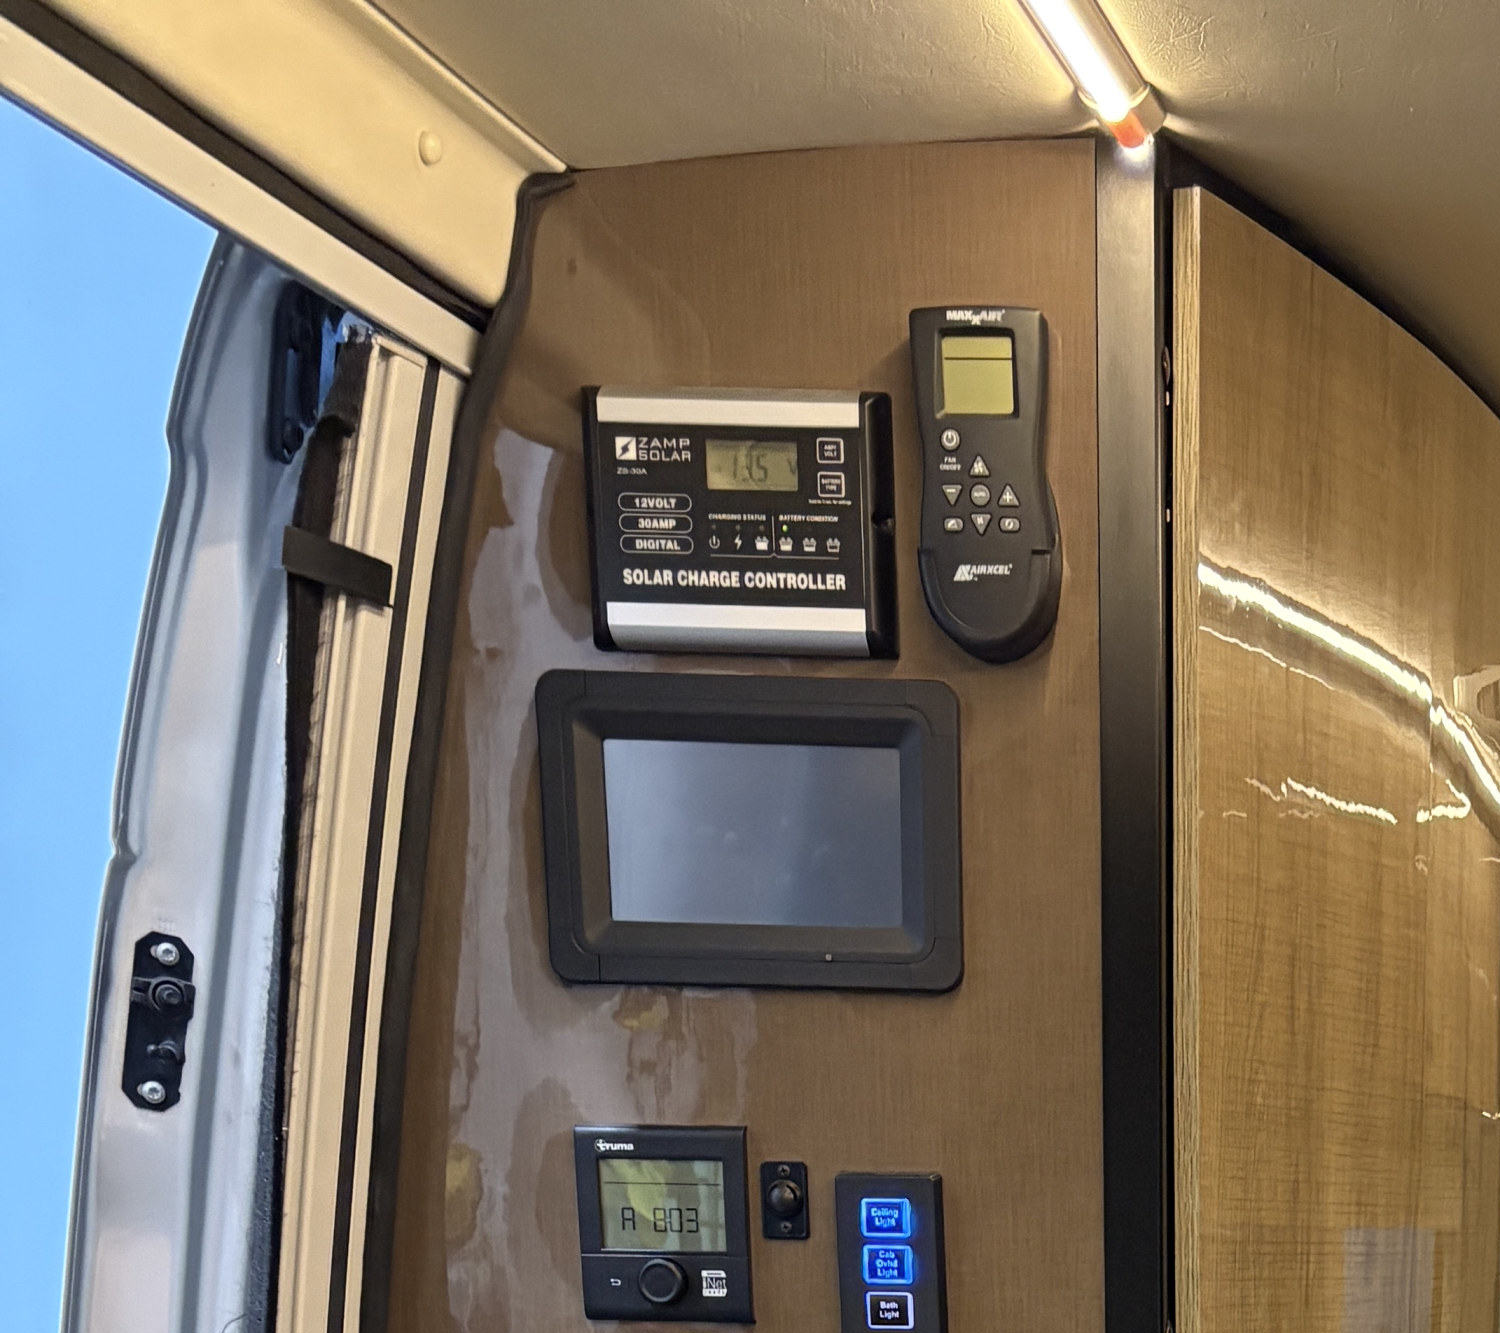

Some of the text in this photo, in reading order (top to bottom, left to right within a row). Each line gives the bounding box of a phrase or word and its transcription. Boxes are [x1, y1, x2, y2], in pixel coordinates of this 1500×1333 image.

[638, 437, 691, 449] ZAMP
[638, 450, 692, 462] SOLAR
[634, 497, 676, 509] 12VOLT
[708, 513, 742, 521] CHARGING
[779, 514, 805, 522] BATTERY
[638, 518, 677, 530] 30AMP
[635, 538, 681, 551] DIGITAL
[622, 568, 847, 590] SOLAR CHARGE CONTROLLER
[595, 1138, 635, 1152] truma
[871, 1207, 899, 1218] Ceiling
[874, 1217, 896, 1228] Light
[879, 1250, 895, 1259] Cab
[877, 1268, 898, 1278] Light
[880, 1301, 898, 1310] Bath
[879, 1310, 899, 1320] Light
